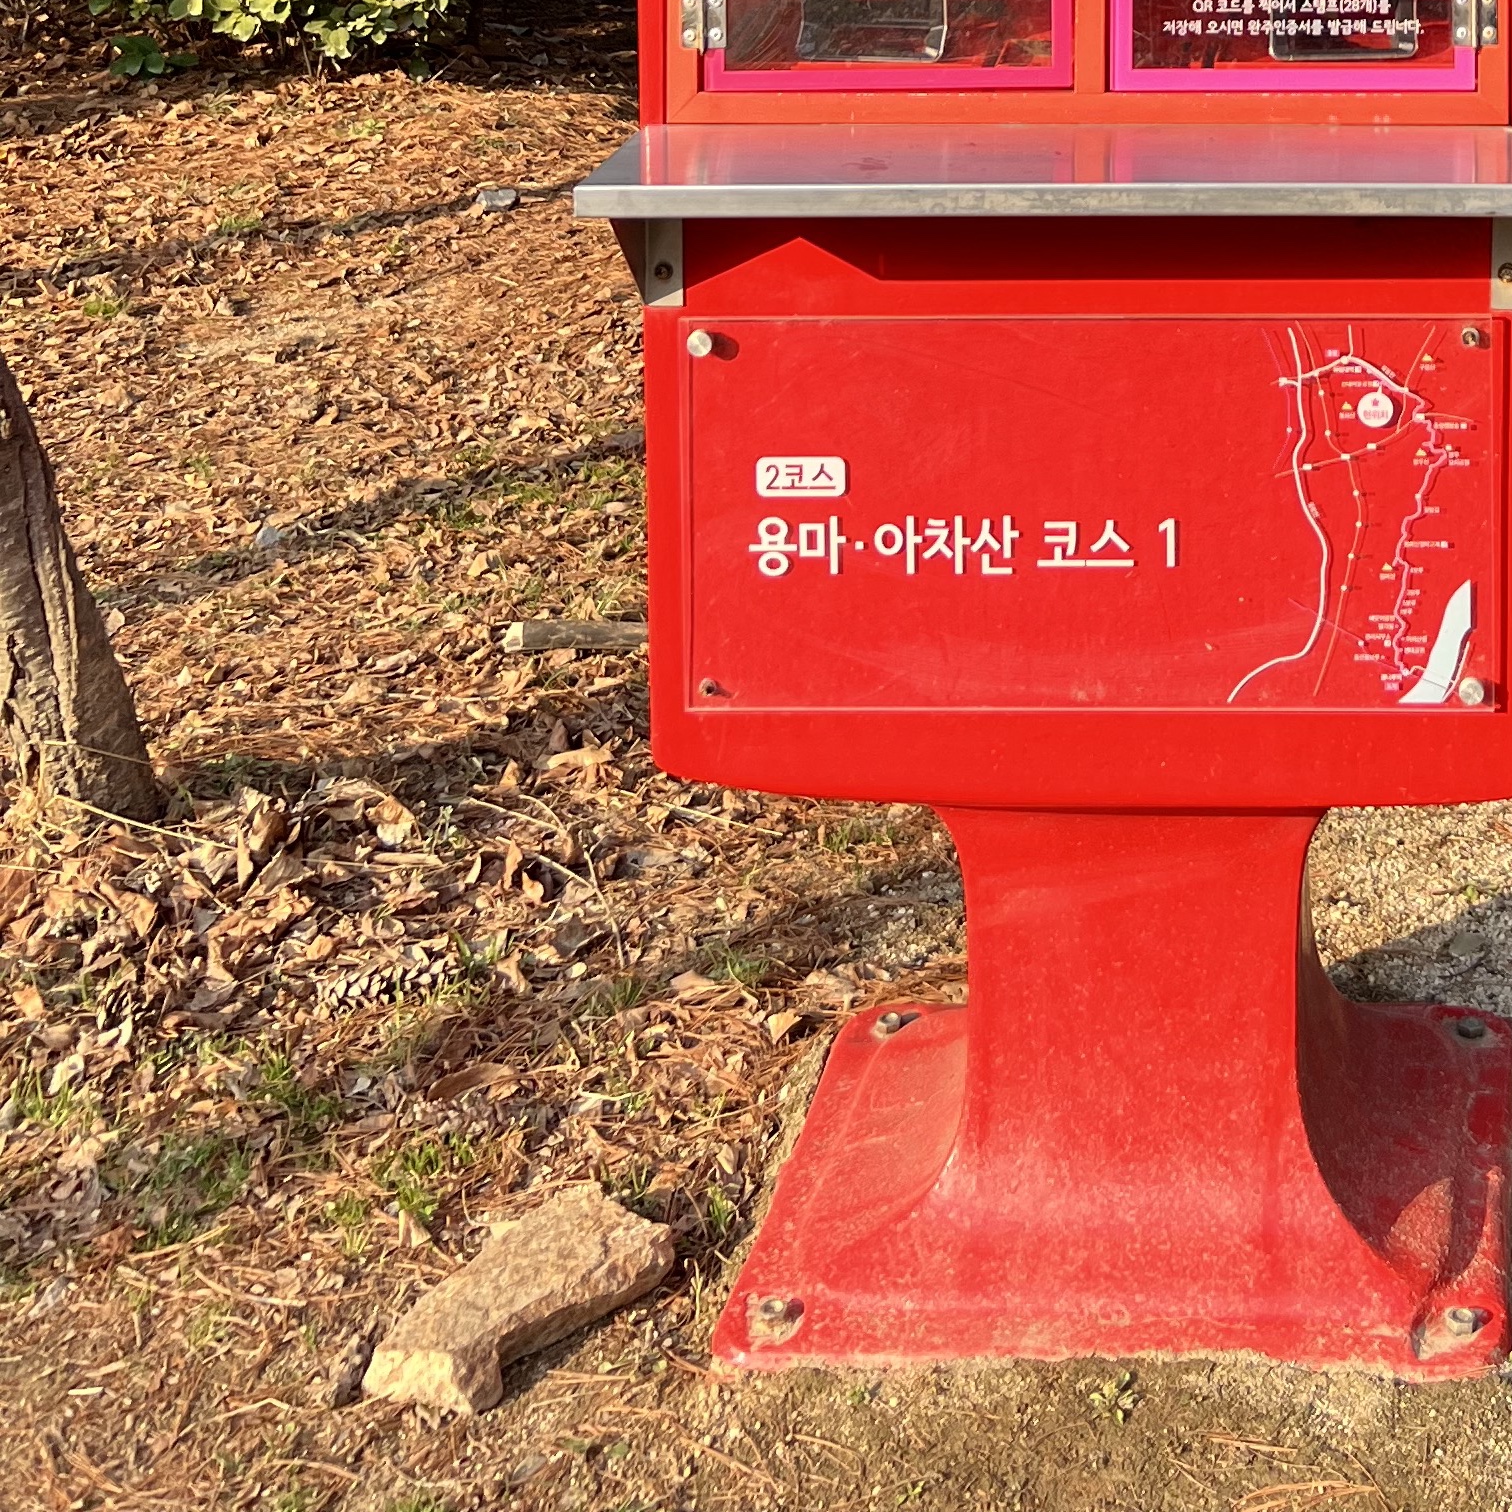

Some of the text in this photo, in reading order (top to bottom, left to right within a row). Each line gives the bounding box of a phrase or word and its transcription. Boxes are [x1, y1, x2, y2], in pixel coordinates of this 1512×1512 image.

[1163, 19, 1202, 35] 저장해
[1206, 19, 1244, 35] 오시면
[1248, 19, 1324, 35] 완주인증서를
[1328, 19, 1366, 36] 발급해
[765, 463, 837, 490] 2코스
[748, 515, 1177, 576] 용마·아차산 코스 1
